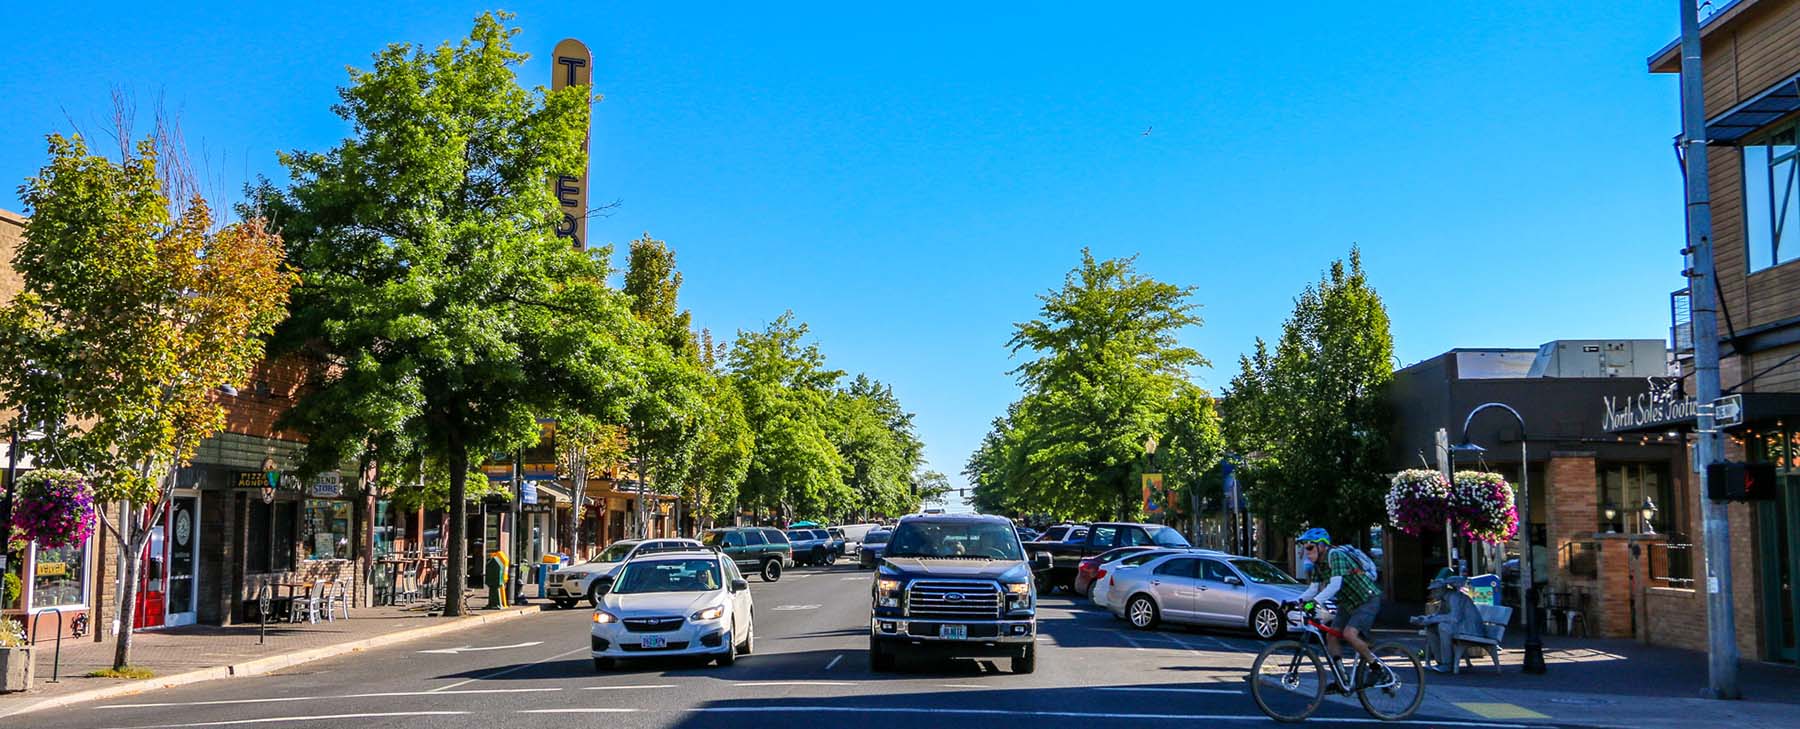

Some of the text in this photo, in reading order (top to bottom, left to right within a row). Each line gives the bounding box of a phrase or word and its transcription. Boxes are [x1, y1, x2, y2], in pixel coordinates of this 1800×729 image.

[557, 55, 586, 248] TER
[1602, 396, 1634, 430] North
[1635, 393, 1663, 426] Soles
[240, 472, 268, 481] PIZZA
[239, 480, 270, 488] MONDO
[313, 484, 338, 494] STORE
